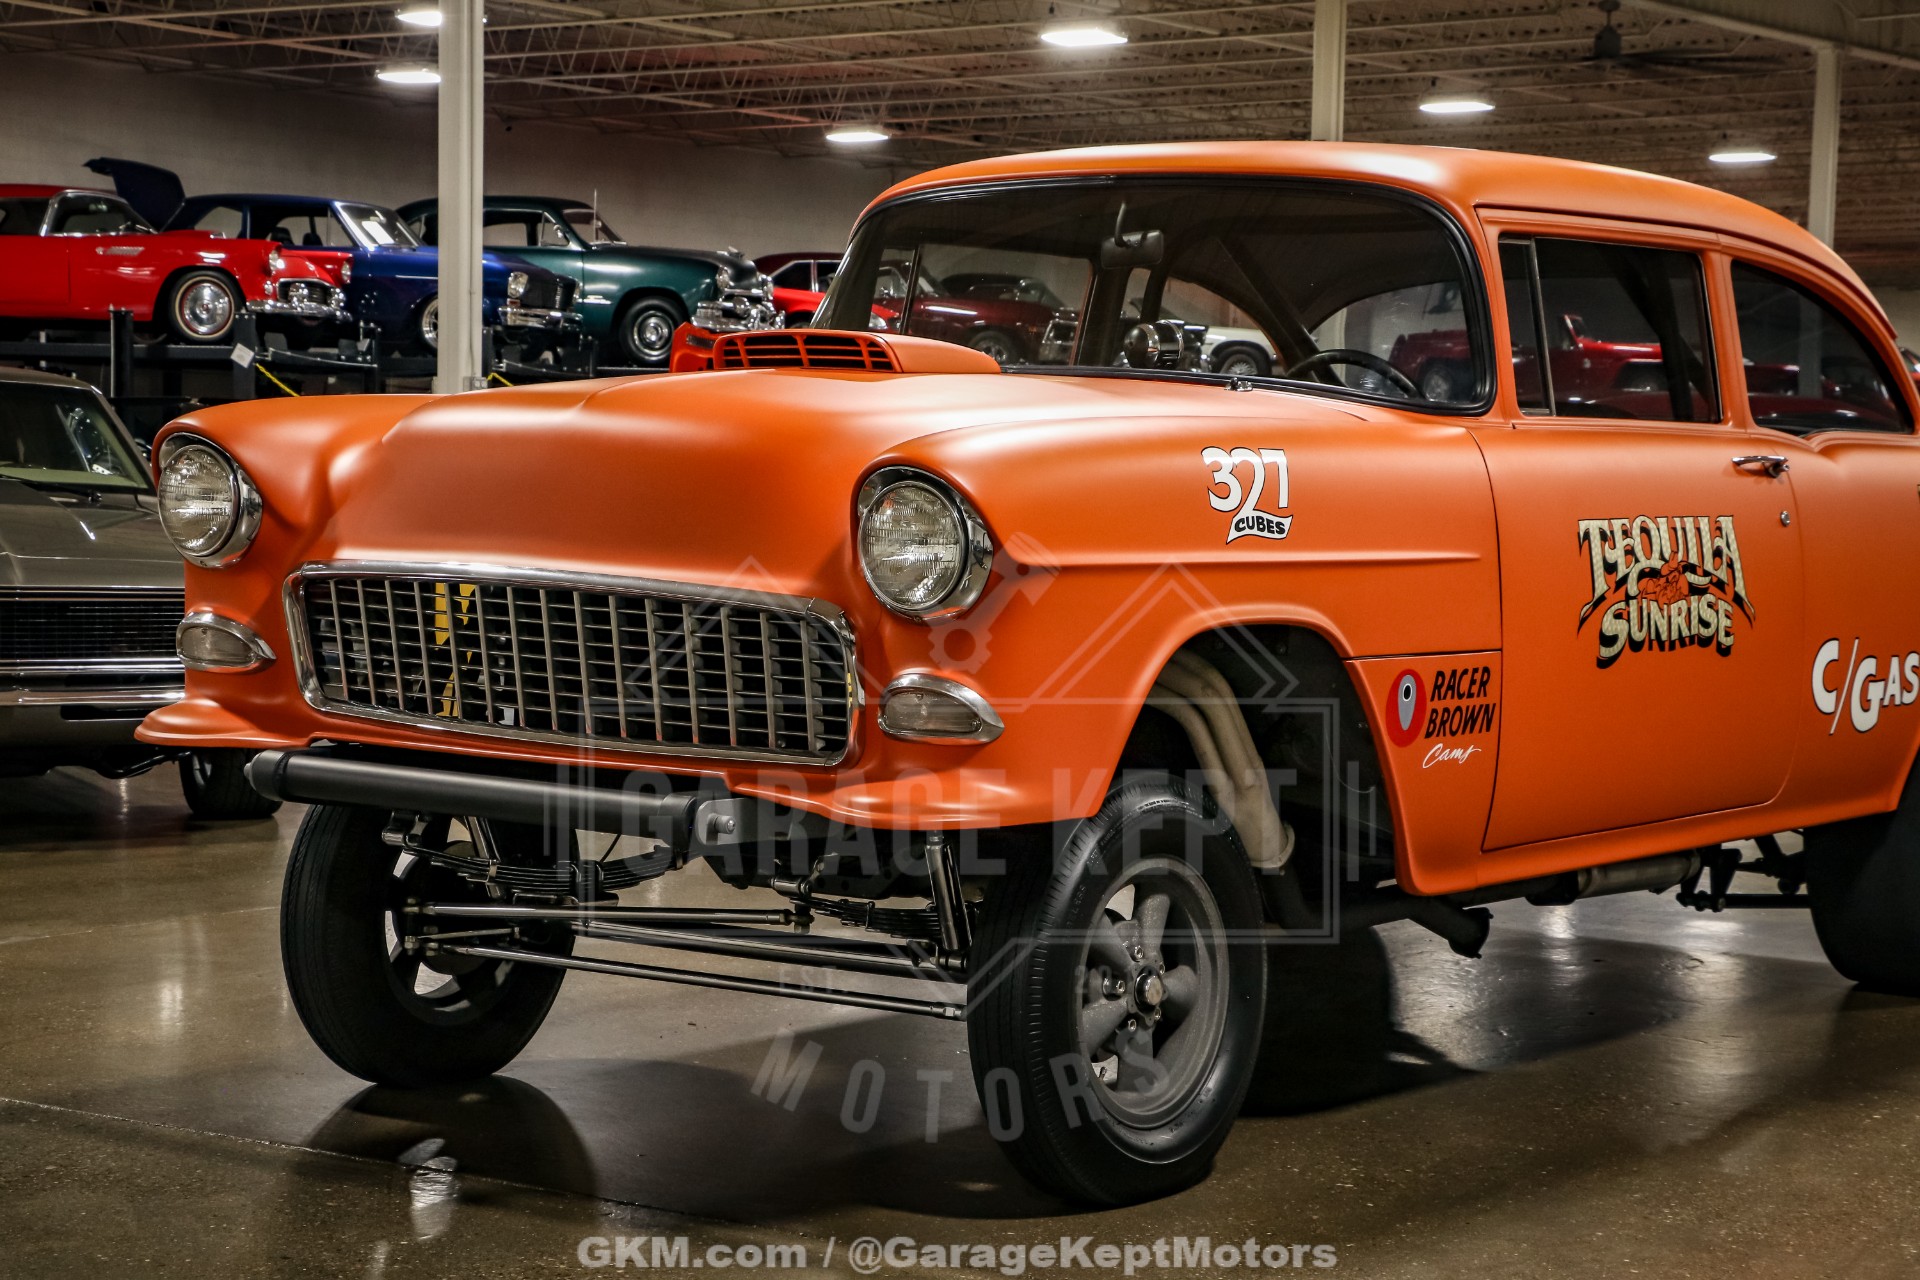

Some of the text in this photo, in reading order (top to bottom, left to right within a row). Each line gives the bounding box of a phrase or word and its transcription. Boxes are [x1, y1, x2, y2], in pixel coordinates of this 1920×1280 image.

[1201, 446, 1293, 545] 327
[1234, 515, 1286, 535] CUBES
[1577, 514, 1756, 638] TEQUILA
[1597, 593, 1735, 669] SUNRISE
[1430, 665, 1491, 702] RACER
[1424, 703, 1497, 739] BROWN
[1422, 743, 1482, 769] Cams
